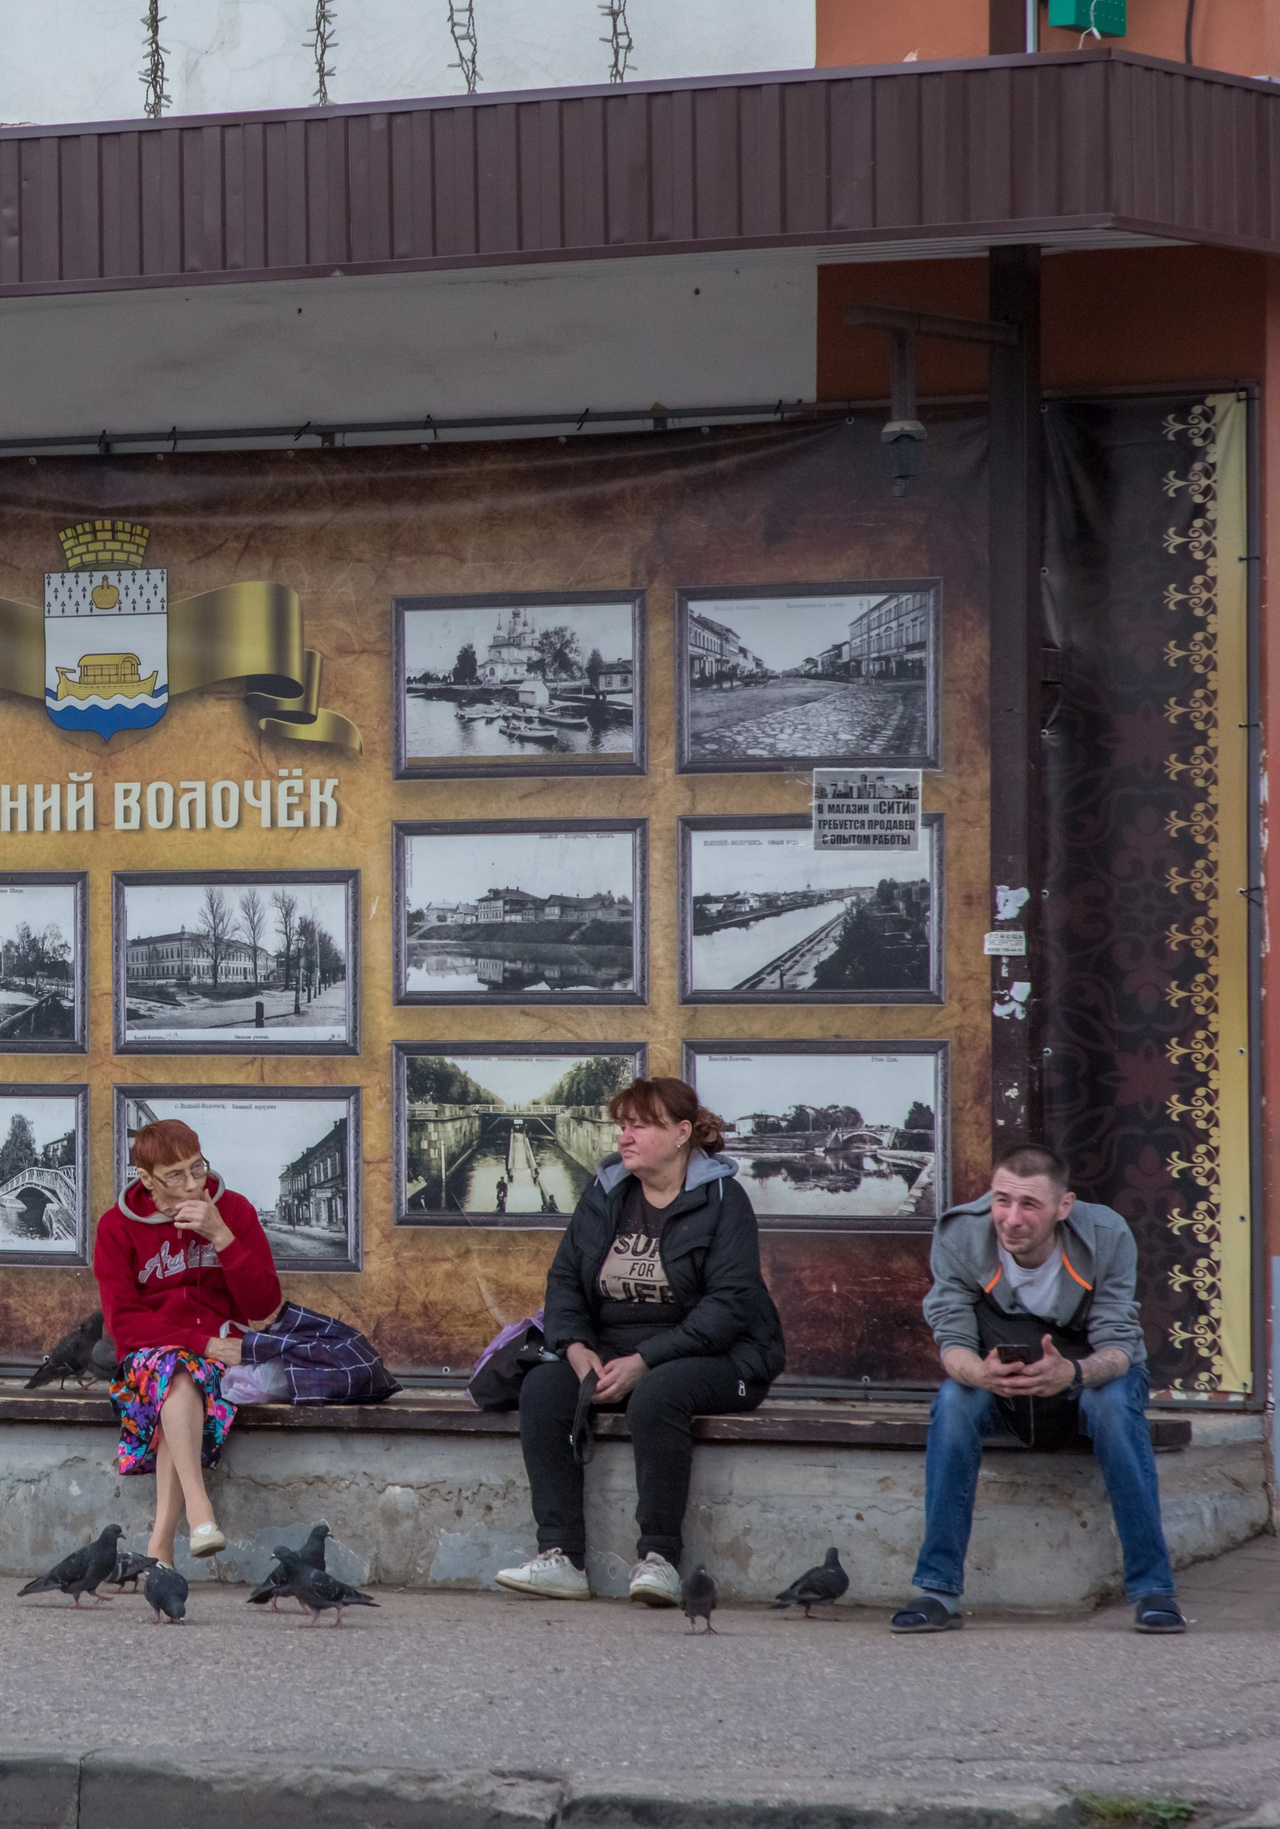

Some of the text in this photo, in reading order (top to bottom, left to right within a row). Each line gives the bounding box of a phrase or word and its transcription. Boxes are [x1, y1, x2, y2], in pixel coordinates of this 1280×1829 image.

[114, 768, 339, 830] ВОЛОЧЁК
[818, 804, 824, 814] В
[827, 804, 869, 814] МАГАЗИН
[818, 820, 916, 831] ТРЕБУЕТСЯ ПРОДАВЕЦ
[822, 834, 911, 845] С ОПЫТОМ РАБОТЫ
[629, 1262, 655, 1277] FOR
